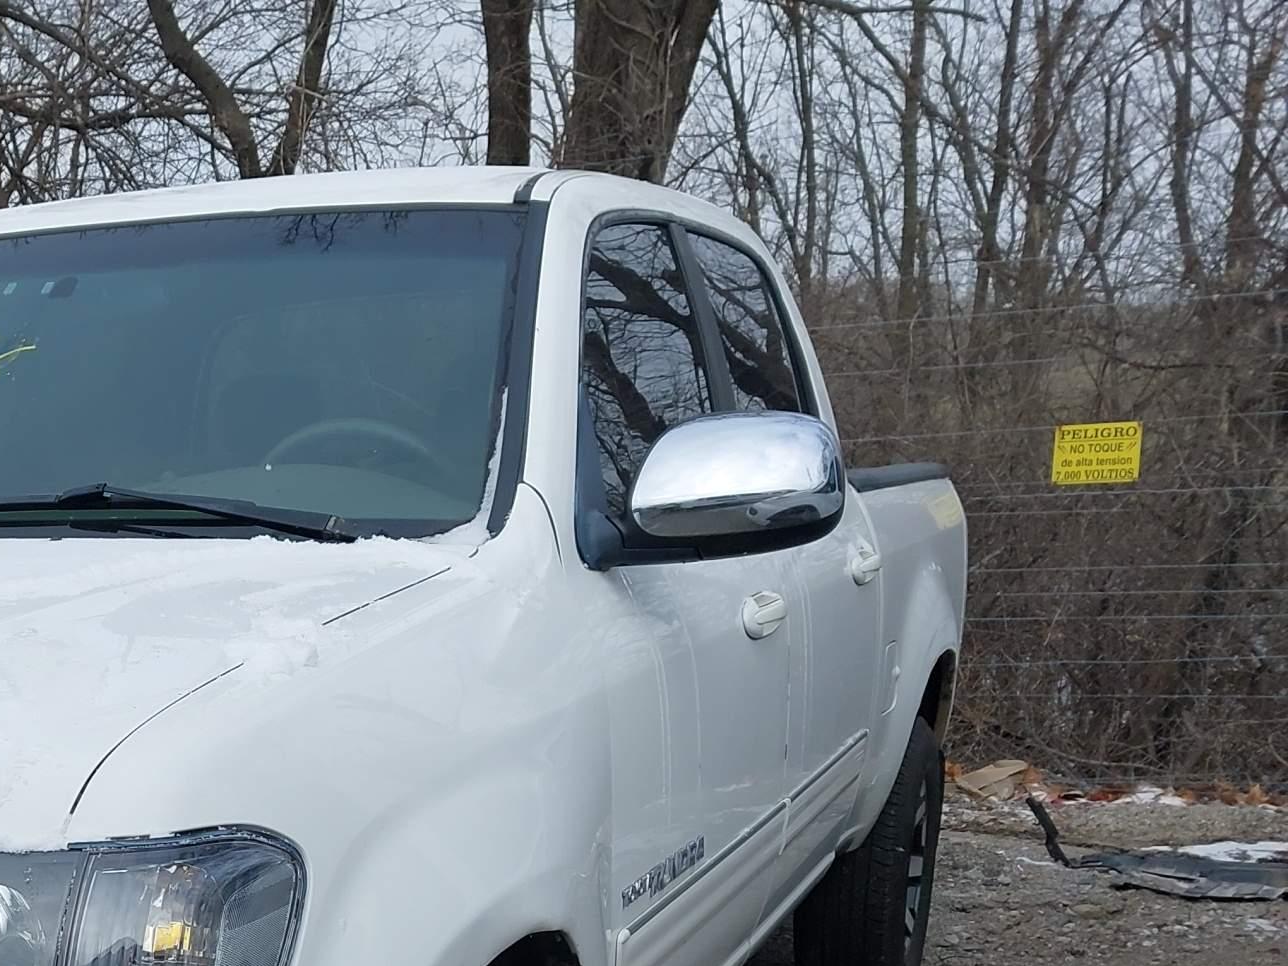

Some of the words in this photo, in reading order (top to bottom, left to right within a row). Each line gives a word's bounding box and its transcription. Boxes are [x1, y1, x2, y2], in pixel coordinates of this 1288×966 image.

[1060, 426, 1138, 441] PELIGRO
[1069, 444, 1085, 454] NO
[1088, 442, 1124, 453] TOQUE
[1061, 458, 1073, 468] de
[1075, 457, 1094, 467] alta
[1095, 455, 1133, 466] tension
[1084, 468, 1135, 481] VOLTIOS
